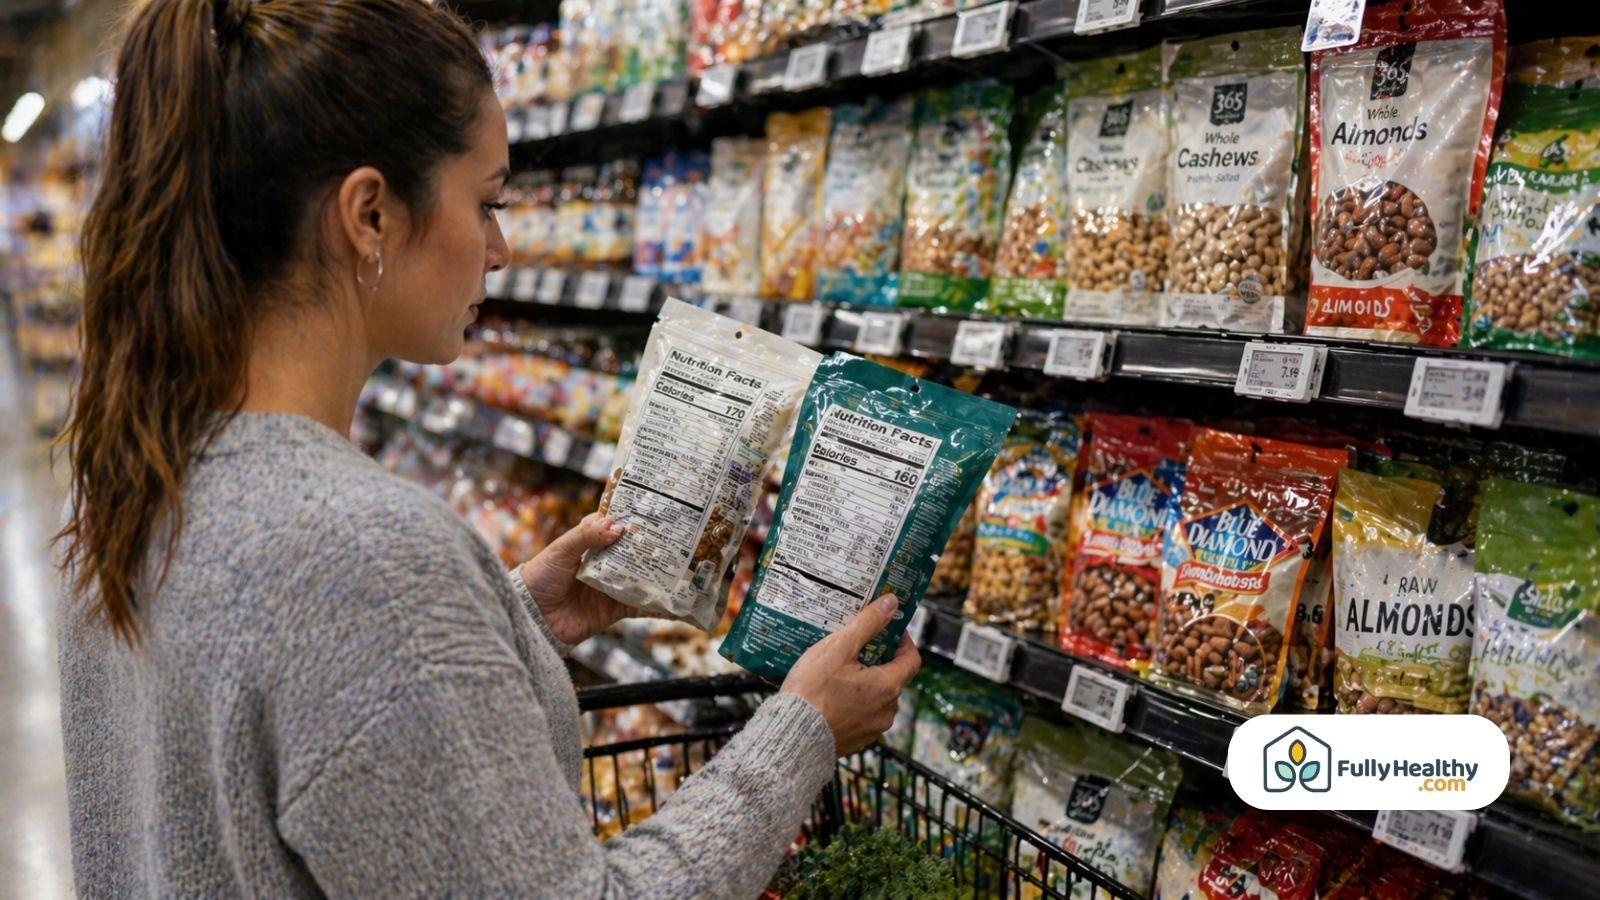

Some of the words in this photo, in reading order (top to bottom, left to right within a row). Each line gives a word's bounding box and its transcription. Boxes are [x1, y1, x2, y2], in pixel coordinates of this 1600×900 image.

[1213, 90, 1244, 114] 365
[1367, 105, 1398, 120] Whole
[1205, 133, 1240, 144] Whole
[1178, 148, 1259, 168] Cashews
[670, 350, 723, 376] Nutrition
[725, 370, 762, 389] Facts
[655, 381, 695, 402] Calories
[725, 405, 746, 419] 170
[829, 409, 887, 434] Nutrition
[891, 427, 933, 449] Facts
[813, 442, 858, 466] Calories
[894, 469, 919, 485] 160
[1215, 509, 1261, 538] BLUE
[1188, 523, 1277, 562] DIAMOND
[1398, 576, 1438, 594] RAW
[1346, 597, 1475, 638] ALMONDS
